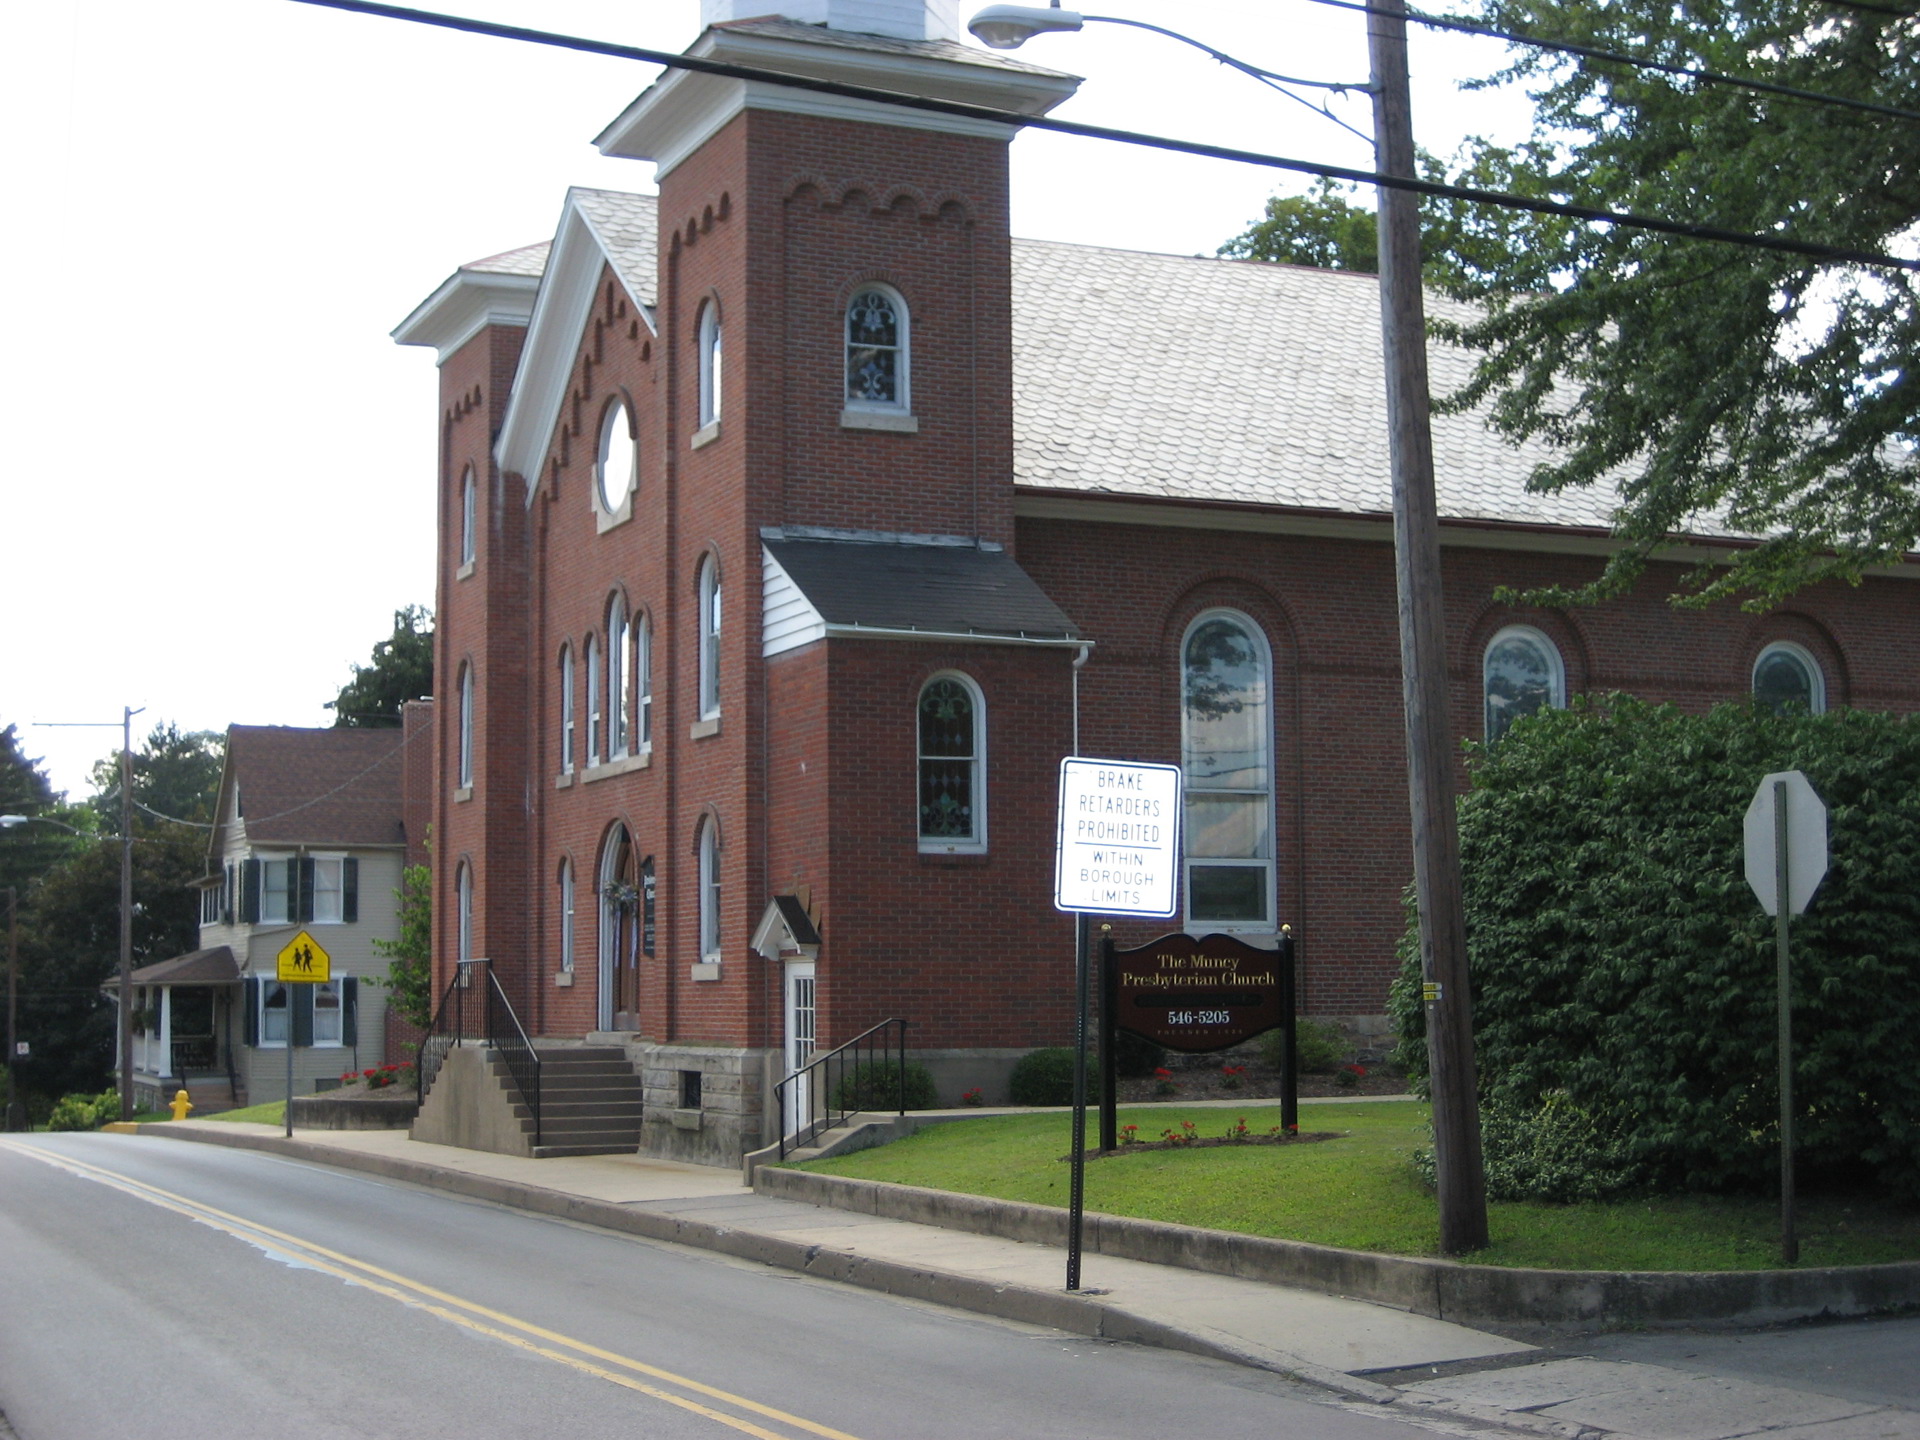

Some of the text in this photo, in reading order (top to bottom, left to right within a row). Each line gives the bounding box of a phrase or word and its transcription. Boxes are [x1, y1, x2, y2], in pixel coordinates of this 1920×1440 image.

[1098, 770, 1144, 791] BRAKE
[1079, 795, 1160, 818] RETARDERS
[1078, 820, 1160, 843] PROHIBITED
[1093, 851, 1143, 867] WITHIN
[1080, 868, 1154, 886] BOROUGH
[1091, 889, 1140, 905] LIMITS
[1157, 954, 1240, 971] The Muncy
[1122, 971, 1276, 989] Presbyterian Church
[1167, 1010, 1230, 1025] 546-5205
